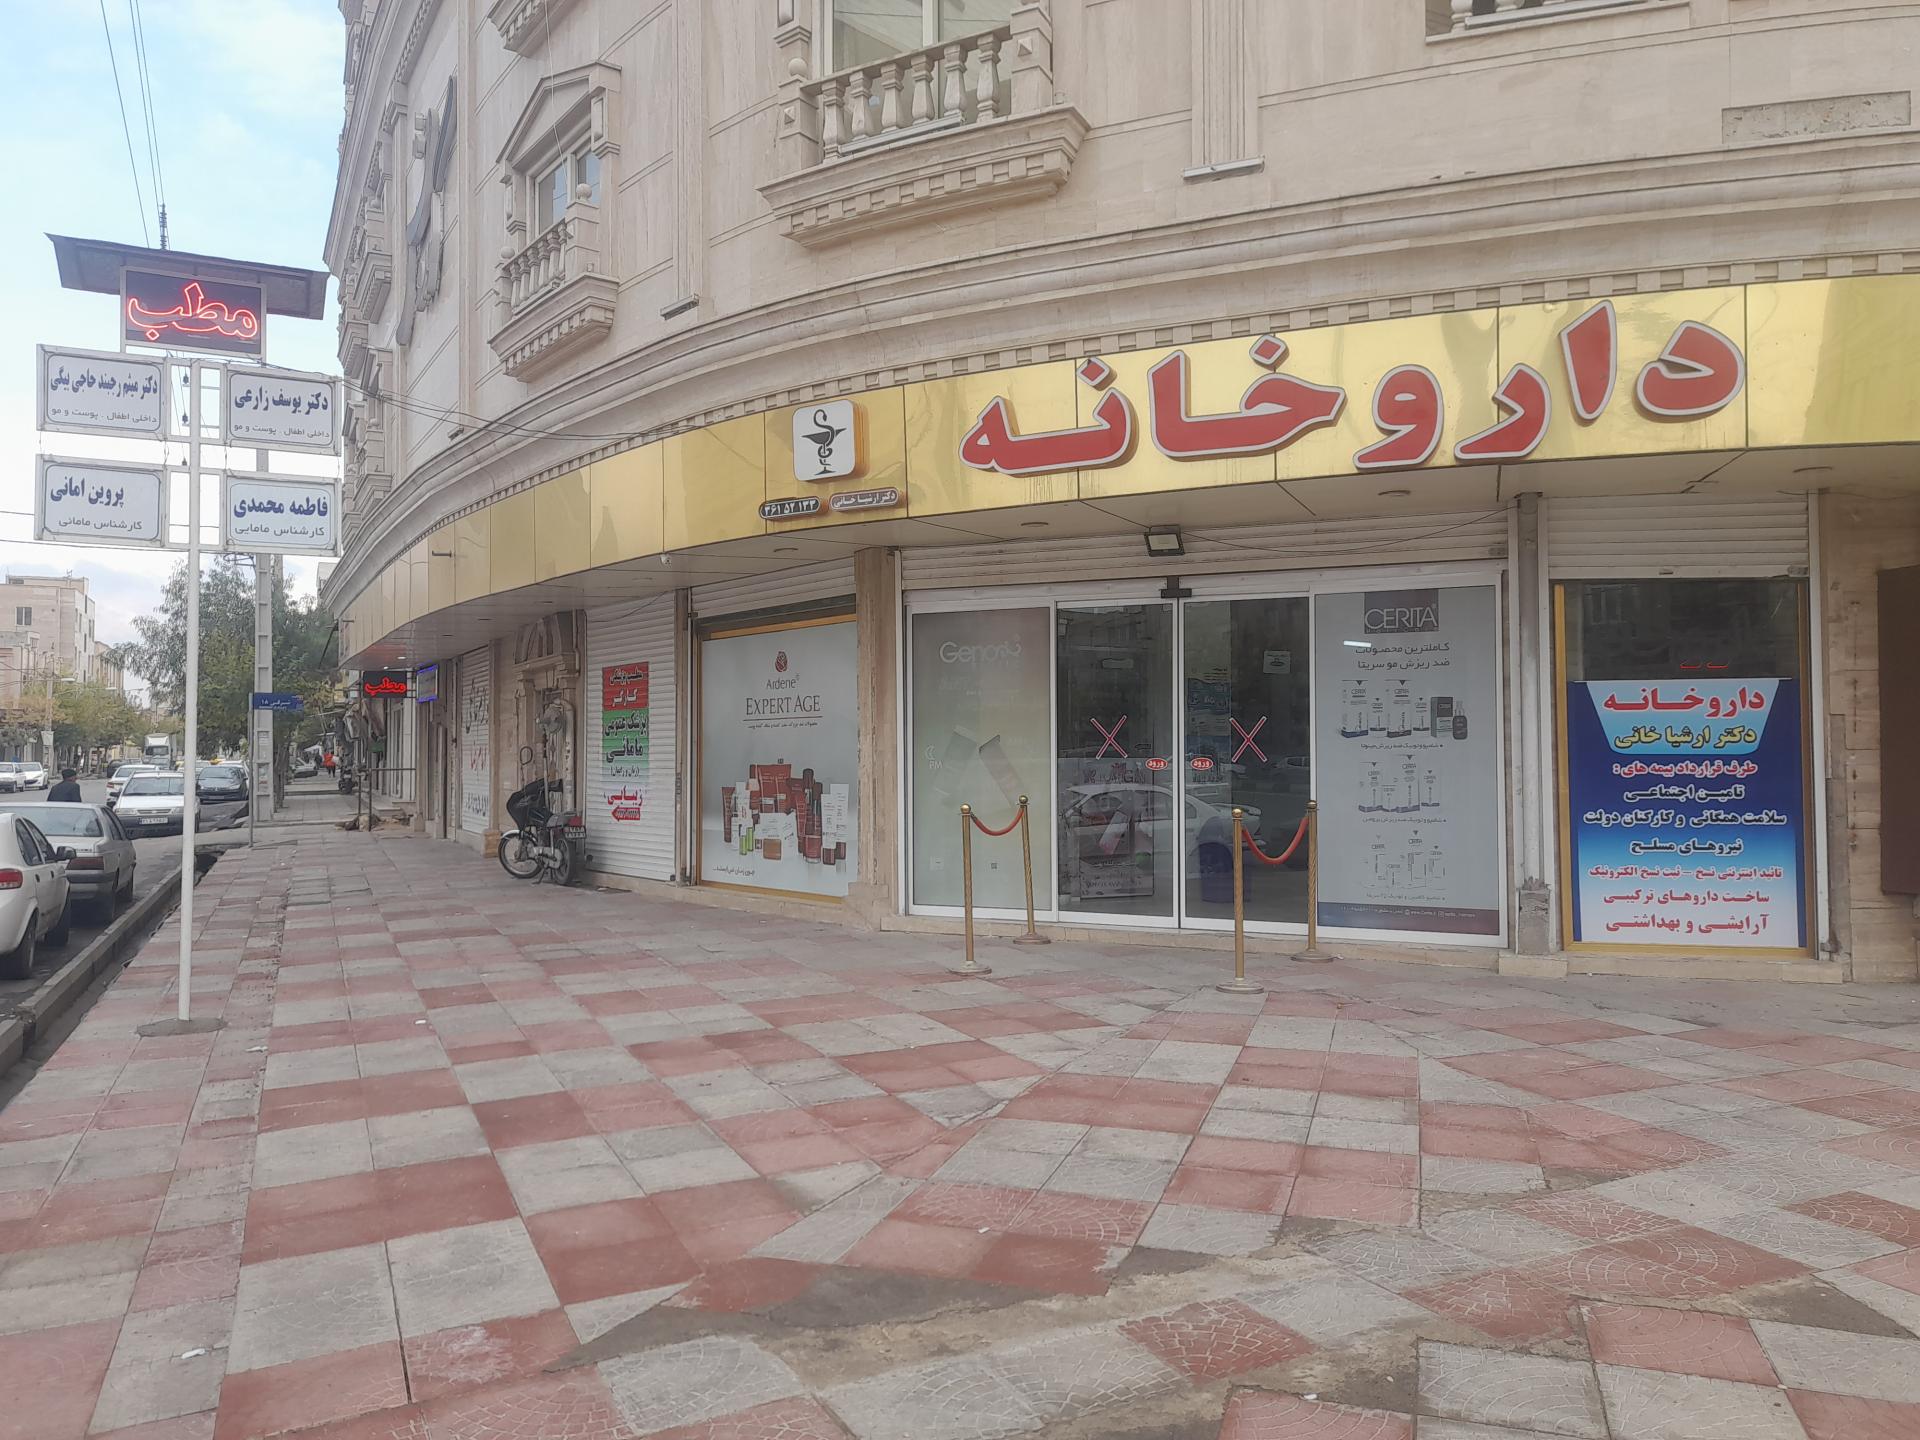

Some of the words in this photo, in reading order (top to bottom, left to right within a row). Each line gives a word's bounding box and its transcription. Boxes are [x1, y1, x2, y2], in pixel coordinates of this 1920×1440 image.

[127, 281, 259, 341] مطب
[140, 374, 158, 400] دکتر
[959, 299, 1747, 475] داروخانه
[234, 385, 269, 411] زارعی
[272, 388, 302, 414] یوسف
[305, 391, 329, 415] دکتر
[132, 414, 157, 423] داخلی
[50, 476, 85, 502] امانی
[88, 485, 124, 508] پروین
[880, 491, 896, 502] دکتر
[234, 497, 285, 518] محمدی
[289, 496, 328, 517] فاطمه
[93, 520, 142, 531] کارشناس
[273, 526, 325, 538] کارشناس
[1364, 606, 1438, 629] CERITA
[1386, 660, 1398, 670] مو
[1400, 658, 1430, 670] ریزش
[1432, 657, 1450, 667] ضد
[364, 676, 407, 697] مطب
[766, 677, 797, 690] Ardene
[746, 696, 791, 716] EXPERT
[794, 694, 821, 713] AGE
[1603, 686, 1765, 718] داروخانه
[1614, 725, 1662, 749] خانی
[1664, 724, 1712, 749] ارشیا
[1713, 725, 1757, 749] دکتر
[1649, 763, 1674, 778] بیمه
[1676, 760, 1724, 779] قرارداد
[1724, 760, 1758, 778] طرف
[1624, 784, 1694, 802] اجتماعی
[1697, 784, 1745, 802] تامین
[1583, 809, 1621, 827] دولت
[1621, 809, 1674, 827] کارکنان
[1675, 814, 1685, 827] و
[1690, 809, 1739, 827] همگانی
[1741, 809, 1787, 825] سلامت
[1630, 837, 1677, 856] مسلح
[1679, 837, 1744, 856] نیروهای
[1589, 865, 1638, 879] الکترونیک
[1640, 866, 1660, 879] نسخ
[1662, 865, 1681, 877] ثبت
[1695, 867, 1716, 880] نسخ
[1717, 867, 1758, 881] اینترنتی
[1603, 889, 1654, 904] ترکیبی
[1657, 889, 1719, 905] داروهای
[1722, 889, 1770, 903] ساخت
[1606, 913, 1681, 933] بهداشتی
[1685, 919, 1694, 934] و
[1698, 913, 1770, 934] آرایشی
